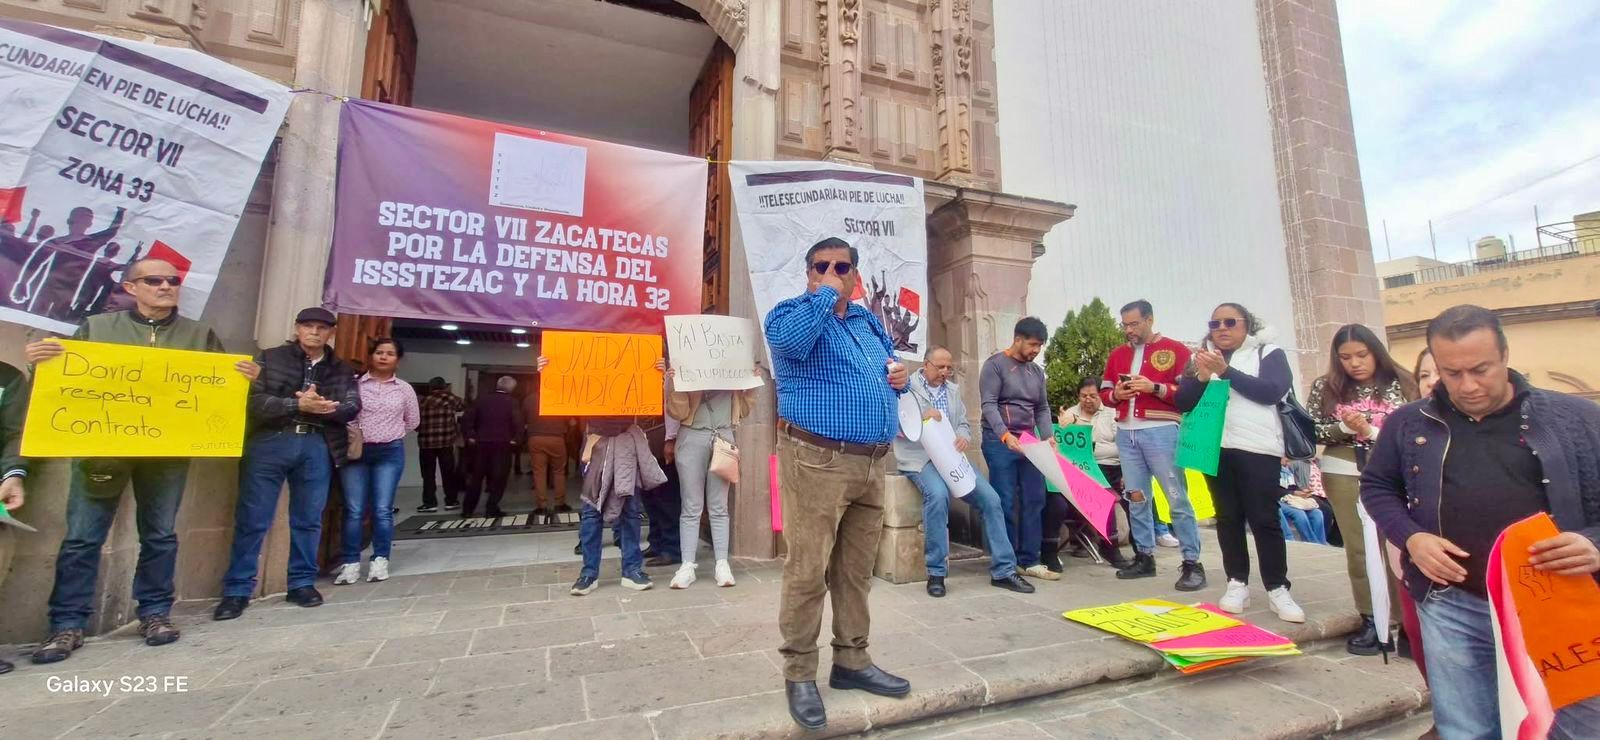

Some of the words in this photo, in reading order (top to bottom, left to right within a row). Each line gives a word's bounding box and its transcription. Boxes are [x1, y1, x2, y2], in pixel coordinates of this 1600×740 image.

[83, 67, 114, 91] EN
[113, 78, 143, 101] PIE
[143, 88, 166, 109] DE
[167, 97, 231, 130] LUCHA!!
[56, 105, 153, 157] SECTOR
[156, 138, 184, 168] VII
[58, 156, 124, 195] ZONA
[127, 178, 155, 203] 33
[838, 189, 848, 201] EN
[850, 190, 862, 203] PIE
[864, 191, 874, 203] DE
[876, 192, 905, 205] LUCHA!!
[378, 201, 485, 236] SECTOR
[494, 215, 527, 240] VII
[534, 220, 669, 259] ZACATECAS
[881, 220, 895, 236] VII
[387, 231, 443, 261] POR
[453, 238, 487, 265] LA
[496, 243, 608, 278] DEFENSA
[615, 256, 657, 283] DEL
[352, 258, 503, 295] ISSSTEZAC
[512, 273, 529, 296] Y
[537, 275, 569, 300] LA
[576, 280, 638, 307] HORA
[644, 288, 670, 310] 32
[62, 351, 144, 383] David
[164, 361, 226, 394] Ingrato
[554, 336, 658, 374] UNIDAD
[59, 385, 153, 411] respeta
[175, 395, 199, 412] el
[50, 406, 162, 438] Contrato
